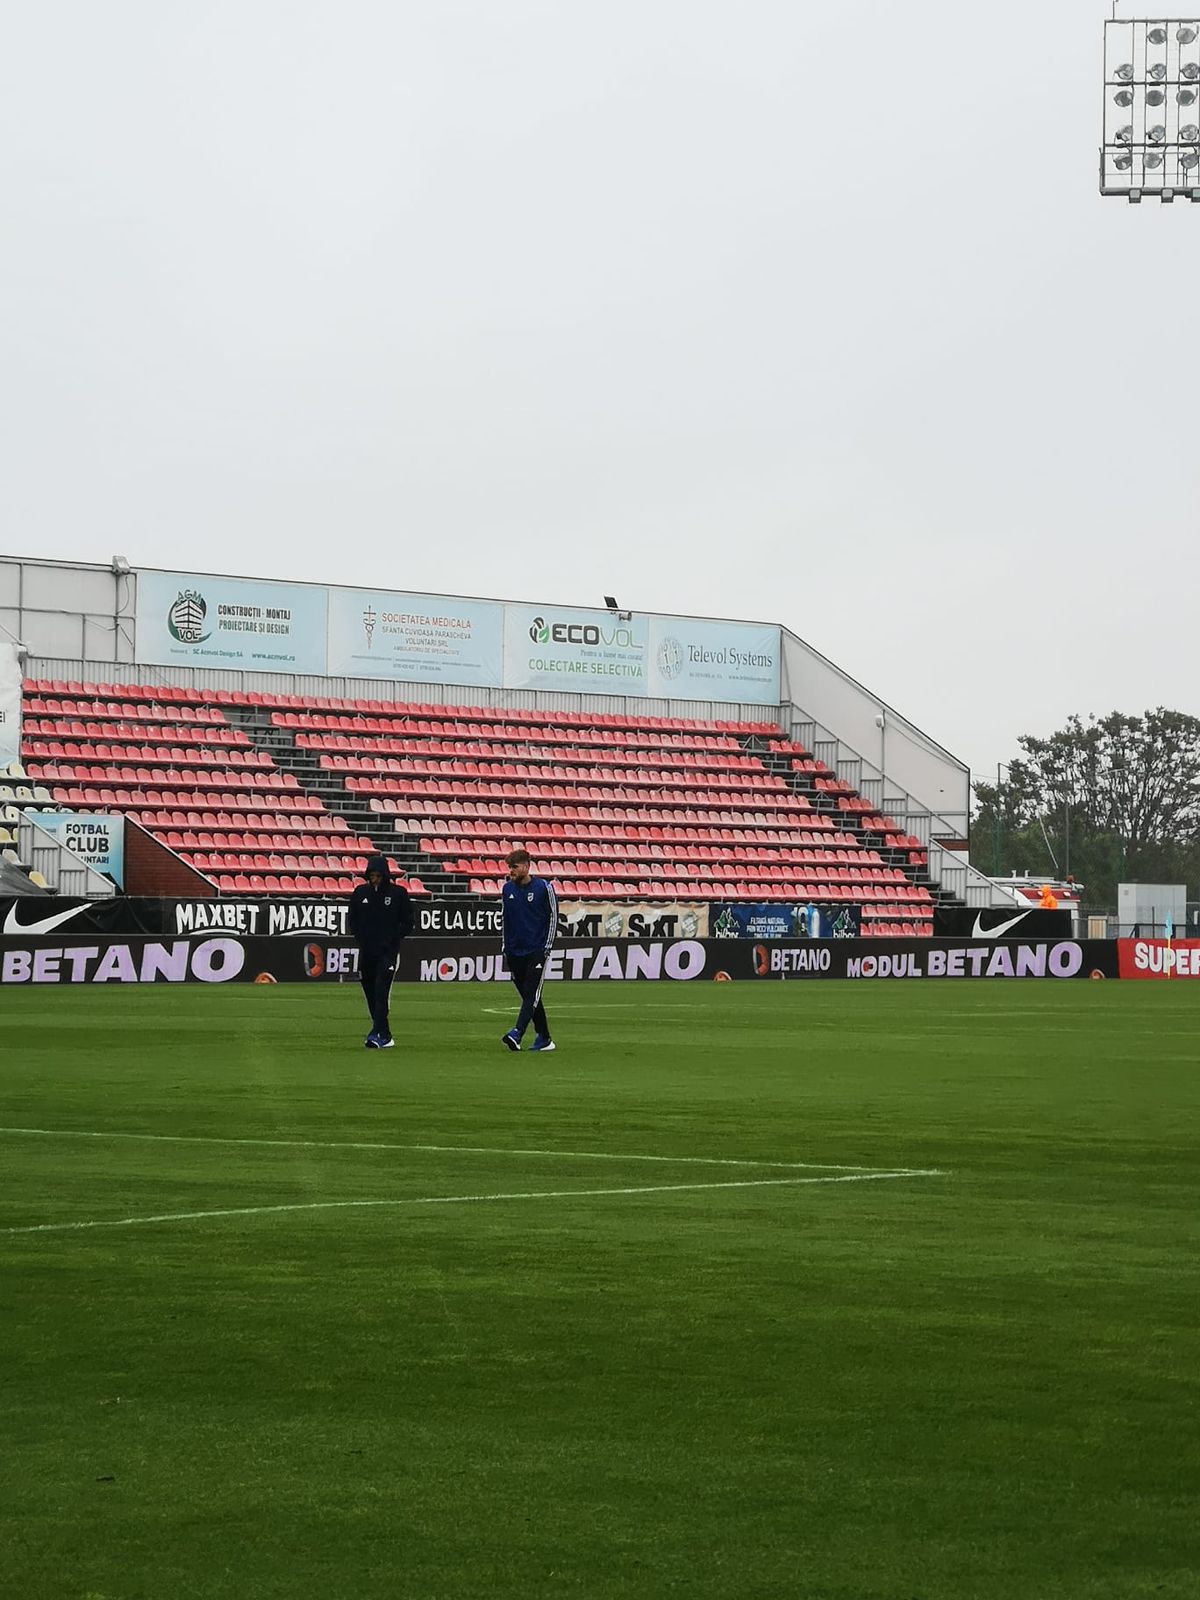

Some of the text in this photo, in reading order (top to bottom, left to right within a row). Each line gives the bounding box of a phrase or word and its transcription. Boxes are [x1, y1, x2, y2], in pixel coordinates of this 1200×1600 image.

[266, 608, 291, 620] MONTAJ
[382, 613, 430, 625] SOCIETATEA
[179, 628, 199, 640] VOL
[218, 619, 257, 632] PROIECTARE
[266, 623, 290, 635] DESIGN
[552, 623, 643, 649] ECOVOL
[528, 658, 588, 673] COLECTARE
[688, 644, 773, 670] Televol Systems
[65, 823, 109, 835] FOTBAL
[65, 836, 109, 853] CLUB
[175, 903, 349, 936] MAXBET MAXBET
[420, 910, 441, 930] DE
[444, 910, 464, 930] LA
[1, 937, 245, 983] BETANO
[420, 940, 706, 982] MODUL ETANO
[770, 948, 831, 971] BETANO
[846, 941, 1083, 978] MODUL BETANO
